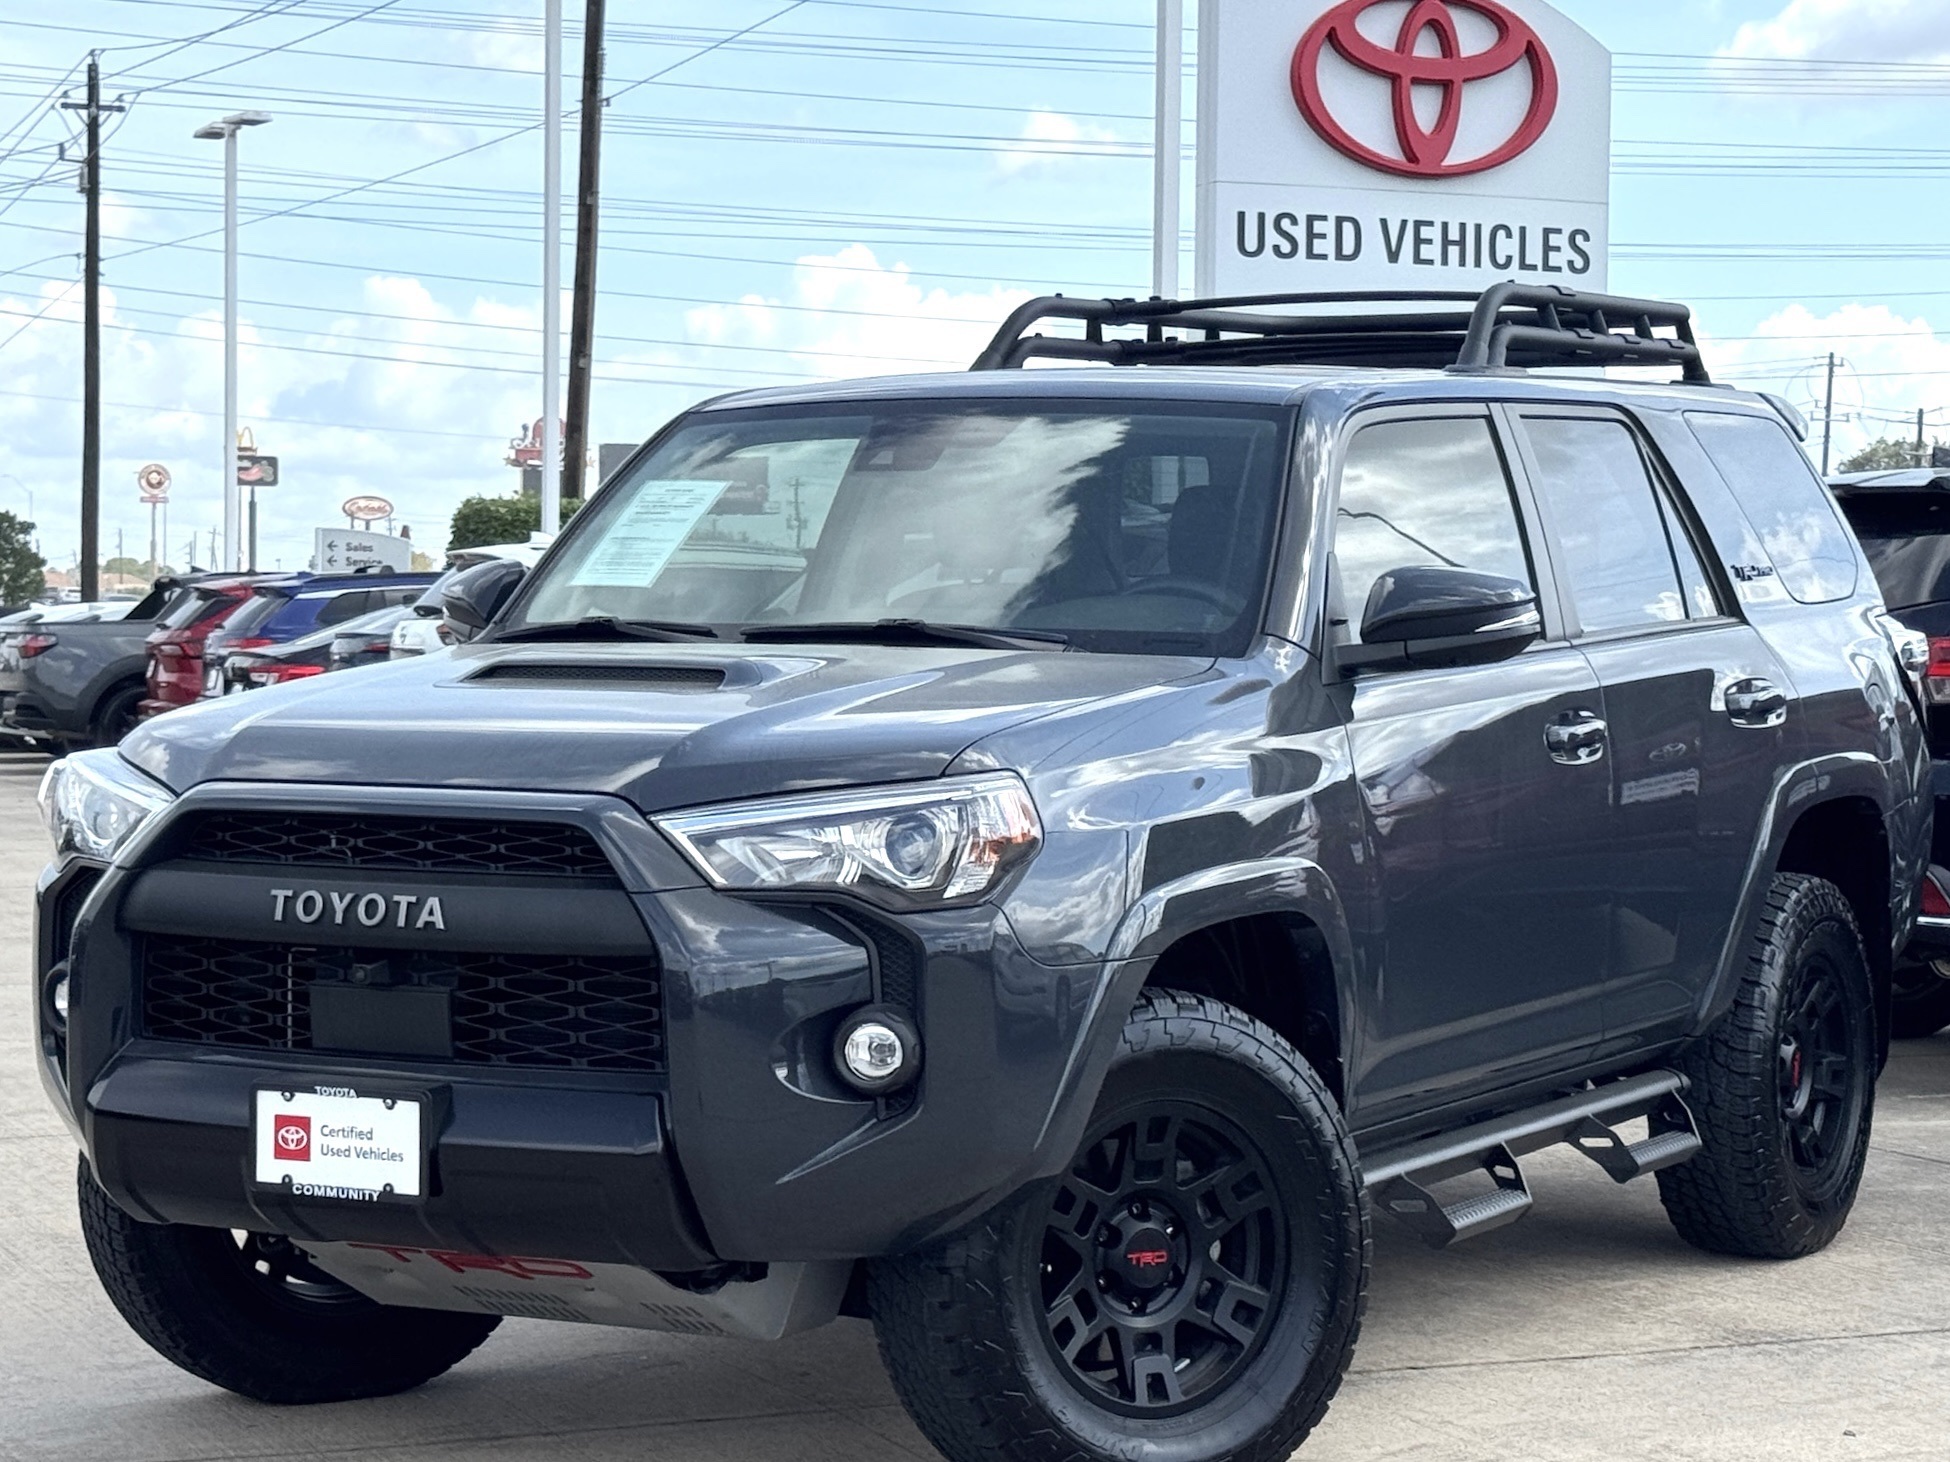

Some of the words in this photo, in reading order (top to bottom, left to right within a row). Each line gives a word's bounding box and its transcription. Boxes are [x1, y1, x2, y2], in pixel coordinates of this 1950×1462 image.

[1236, 210, 1363, 261] USED
[1378, 217, 1592, 275] VEHICLES
[345, 541, 374, 552] Sales
[270, 889, 446, 931] TOYOTA
[314, 1085, 358, 1099] TOYOTA
[320, 1124, 374, 1141] Certified
[320, 1143, 350, 1158] Used
[354, 1146, 404, 1162] Vehicles
[292, 1184, 382, 1202] COMMUNITY
[346, 1240, 595, 1280] TRD
[1127, 1251, 1168, 1268] TRD
